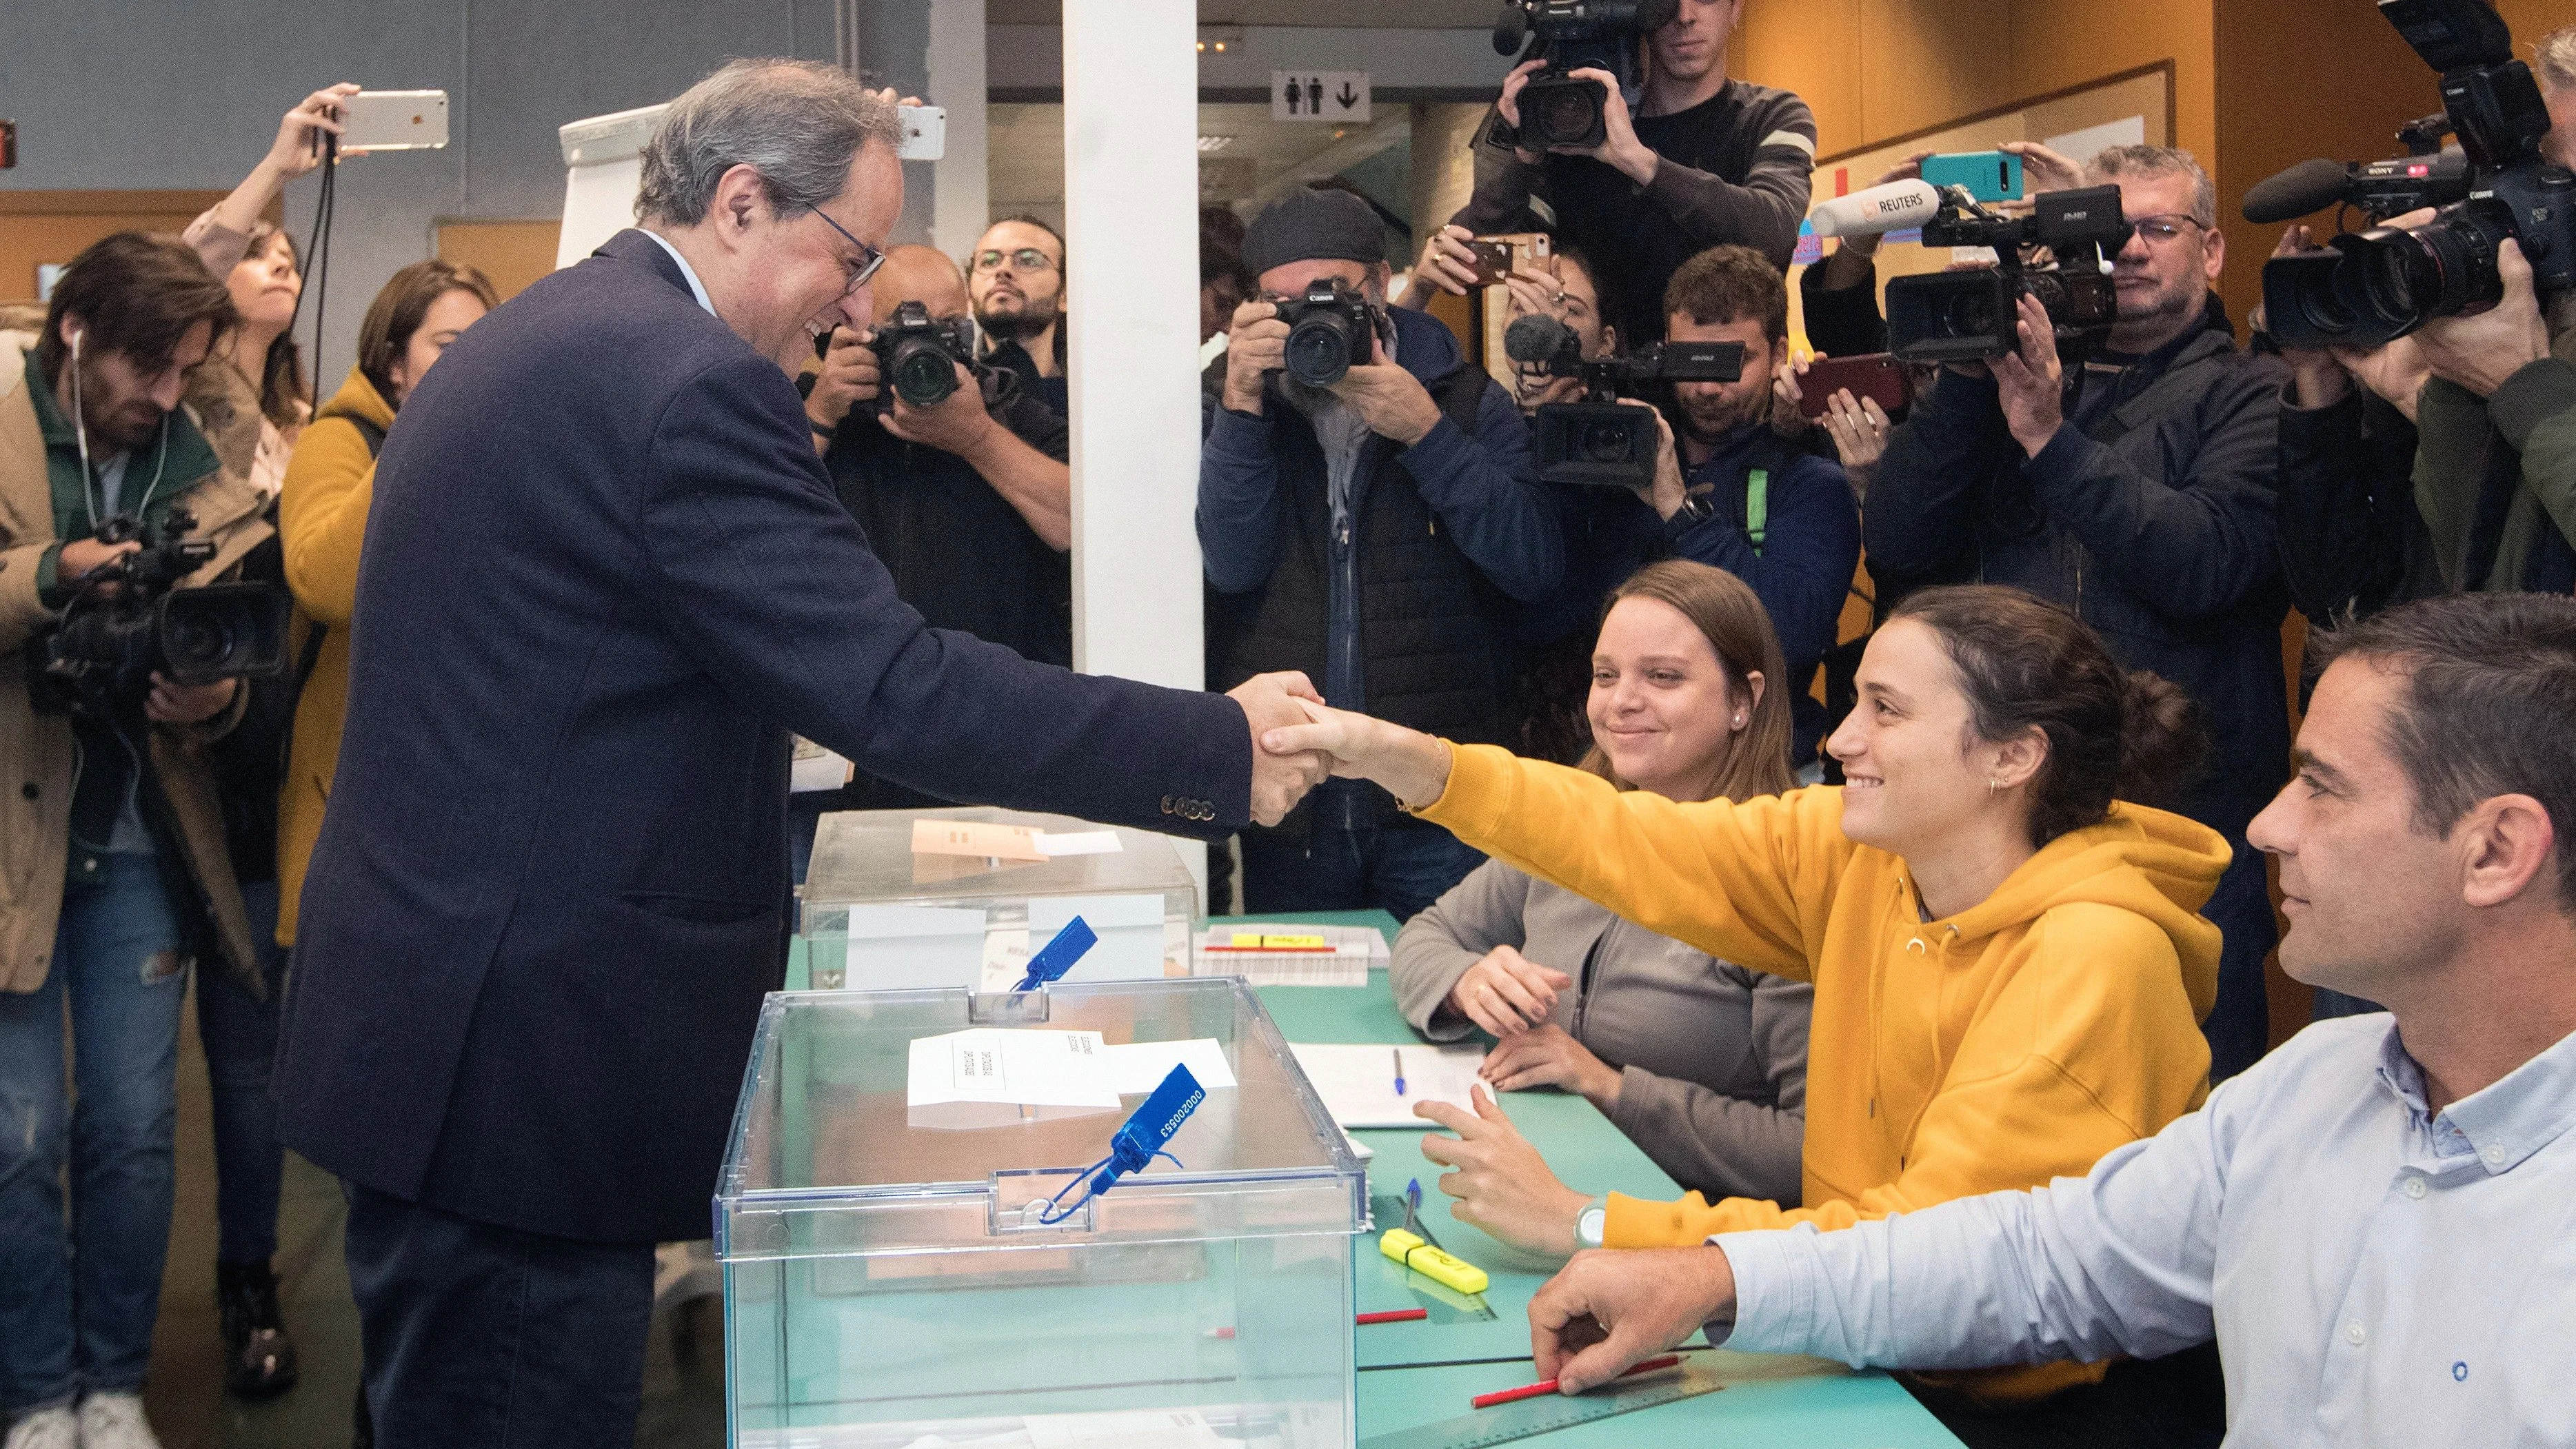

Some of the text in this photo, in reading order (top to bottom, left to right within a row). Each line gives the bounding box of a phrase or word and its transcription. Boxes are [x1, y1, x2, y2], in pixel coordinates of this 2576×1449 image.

[2368, 167, 2393, 175] SONY
[2469, 190, 2493, 200] Canon
[1879, 193, 1923, 212] REUTERS
[1160, 1090, 1203, 1137] 000200553
